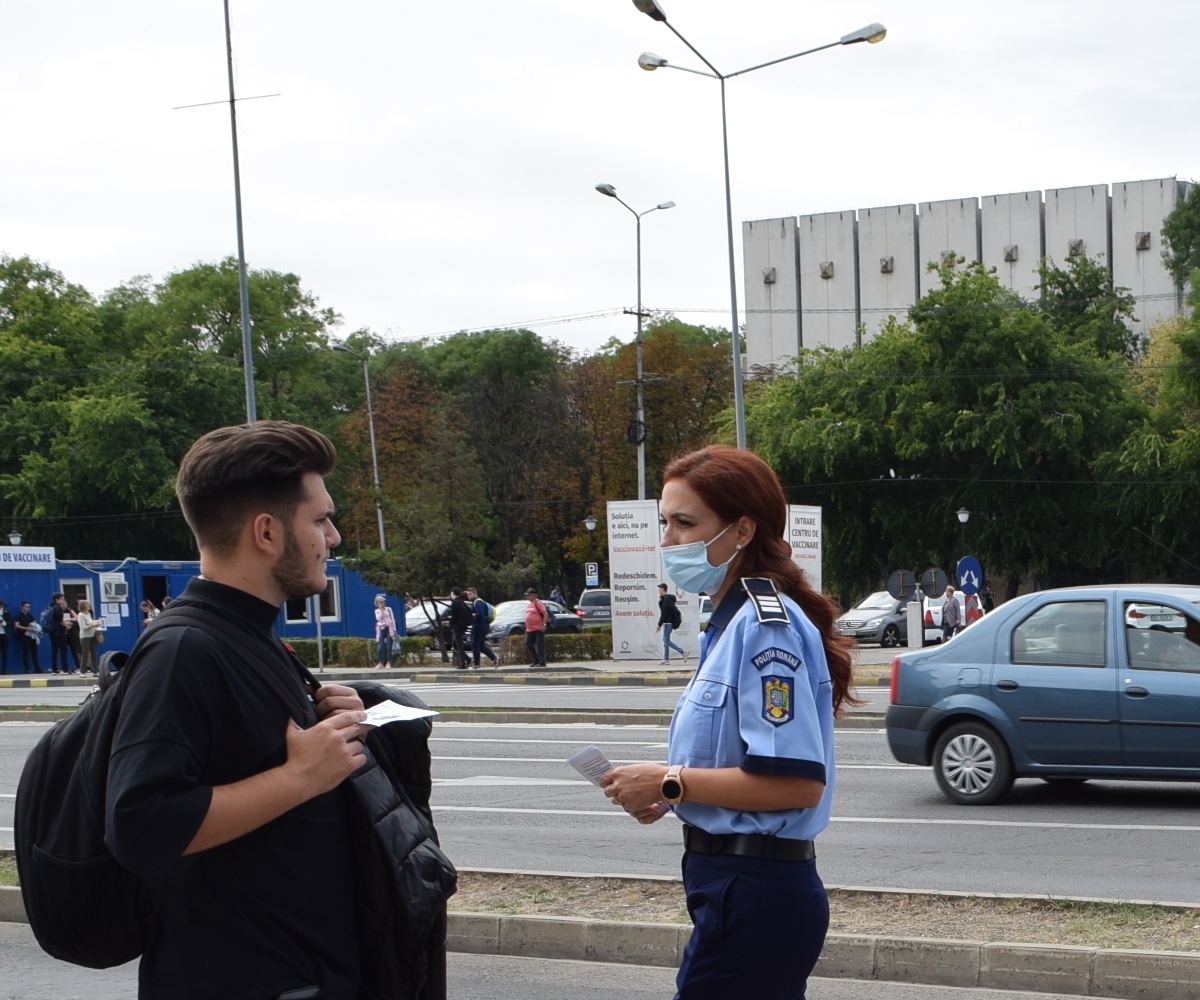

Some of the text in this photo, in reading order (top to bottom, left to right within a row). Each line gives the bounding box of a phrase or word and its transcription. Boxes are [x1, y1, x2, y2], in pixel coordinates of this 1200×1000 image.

[611, 511, 633, 520] Soluția
[617, 521, 630, 530] aici,
[640, 522, 649, 530] pe
[794, 517, 816, 526] INTRARE
[612, 531, 640, 540] internet.
[791, 529, 819, 538] CENTRU DE
[612, 545, 656, 553] Vaccinează-te!
[791, 540, 819, 549] VACCINARE
[3, 552, 12, 562] DE
[12, 552, 52, 563] VACCINARE
[613, 571, 658, 579] Redeschidem.
[614, 582, 647, 592] Repornim.
[614, 594, 640, 604] Reușim.
[633, 608, 655, 618] soluția.
